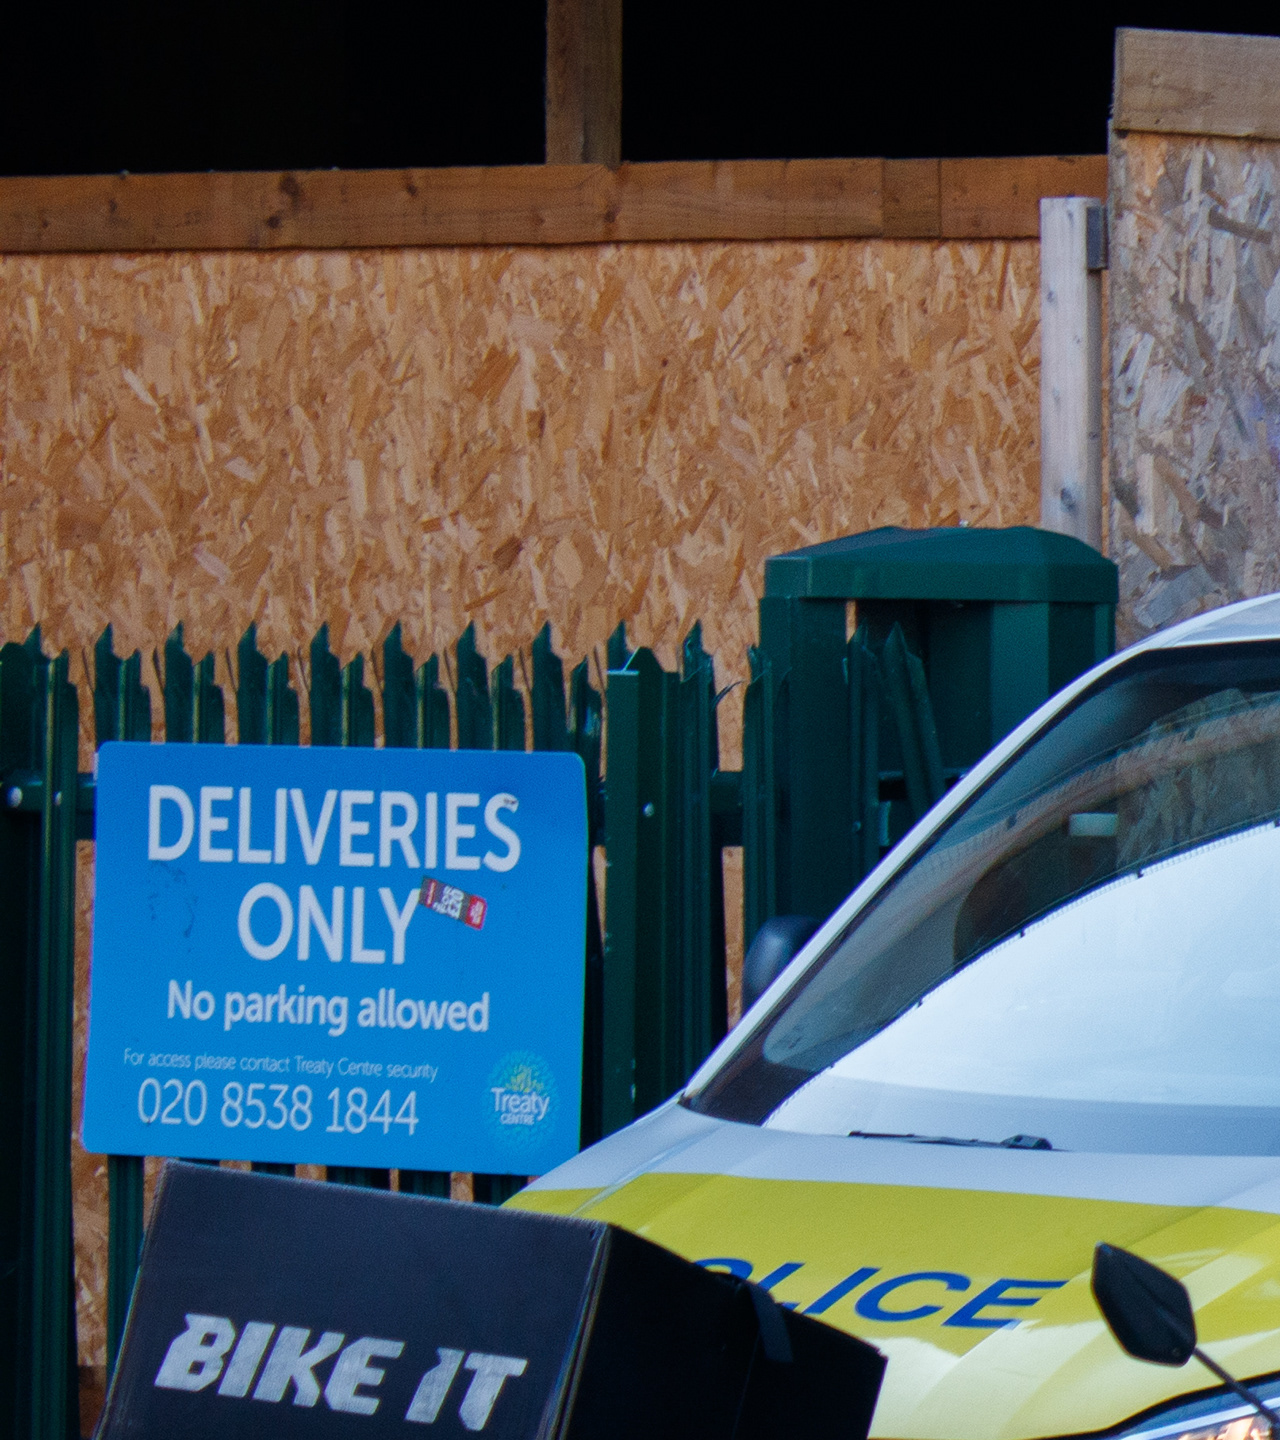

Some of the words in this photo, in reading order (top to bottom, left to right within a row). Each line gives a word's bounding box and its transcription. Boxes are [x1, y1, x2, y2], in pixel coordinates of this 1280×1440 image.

[147, 784, 521, 873] DELIVERIES
[237, 882, 421, 965] ONLY
[167, 979, 215, 1021] No
[223, 984, 348, 1037] parking
[357, 988, 490, 1033] allowed
[123, 1047, 145, 1066] For
[147, 1051, 191, 1068] access
[194, 1051, 236, 1072] please
[239, 1055, 291, 1073] contact
[293, 1055, 334, 1079] Treaty
[337, 1057, 383, 1078] Centre
[386, 1062, 439, 1083] security
[137, 1077, 208, 1126] 020
[220, 1081, 314, 1132] 8538
[325, 1086, 419, 1136] 1844
[490, 1086, 550, 1121] Treaty
[499, 1112, 535, 1126] CENTRE
[154, 1312, 404, 1416] BIKE
[405, 1346, 528, 1431] IT
